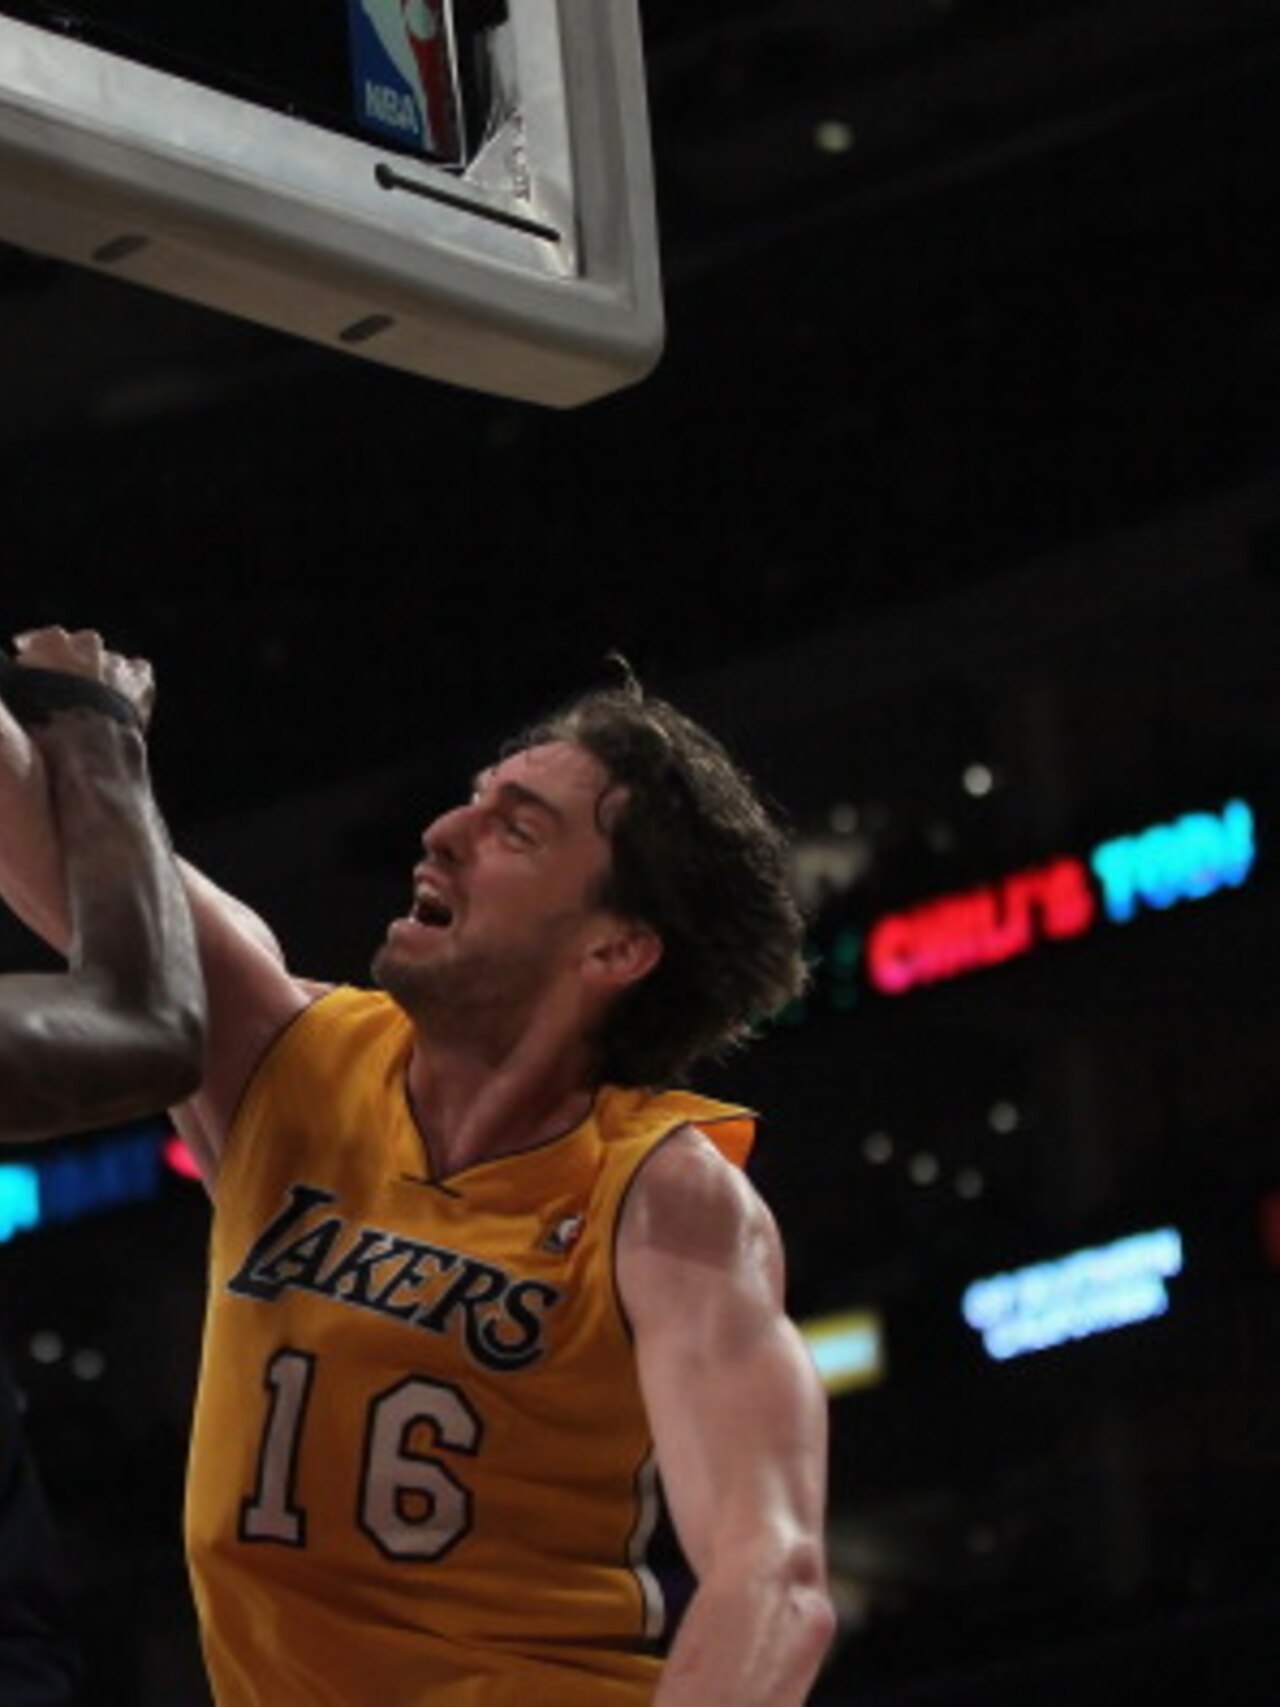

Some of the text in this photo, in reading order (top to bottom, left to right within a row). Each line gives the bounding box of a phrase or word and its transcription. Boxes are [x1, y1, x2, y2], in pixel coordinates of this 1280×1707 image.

[364, 80, 419, 134] NBA
[227, 1183, 563, 1372] LAKERS
[238, 1345, 485, 1562] 16
